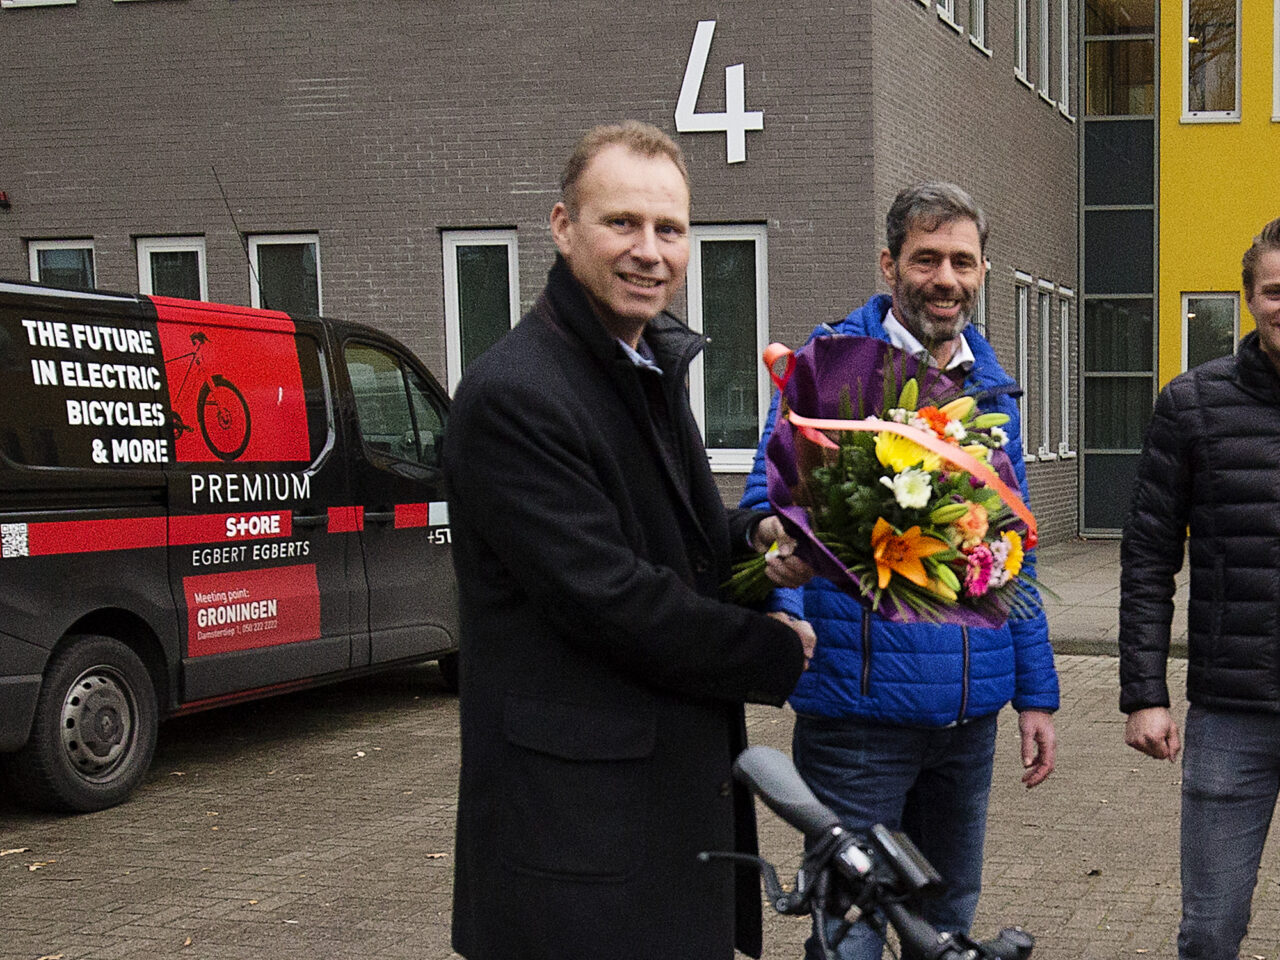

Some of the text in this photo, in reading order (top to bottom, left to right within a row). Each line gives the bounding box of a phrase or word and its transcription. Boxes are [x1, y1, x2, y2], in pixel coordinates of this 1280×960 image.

[674, 20, 764, 164] 4
[21, 319, 155, 355] THE FUTURE
[31, 359, 161, 391] IN ELECTRIC
[66, 399, 165, 427] BICYCLES
[92, 438, 169, 464] & MORE
[190, 472, 311, 504] PREMIUM
[192, 540, 310, 567] EGBERT EGBERTS
[194, 588, 250, 604] Meeting point:
[197, 598, 277, 628] GRONINGEN
